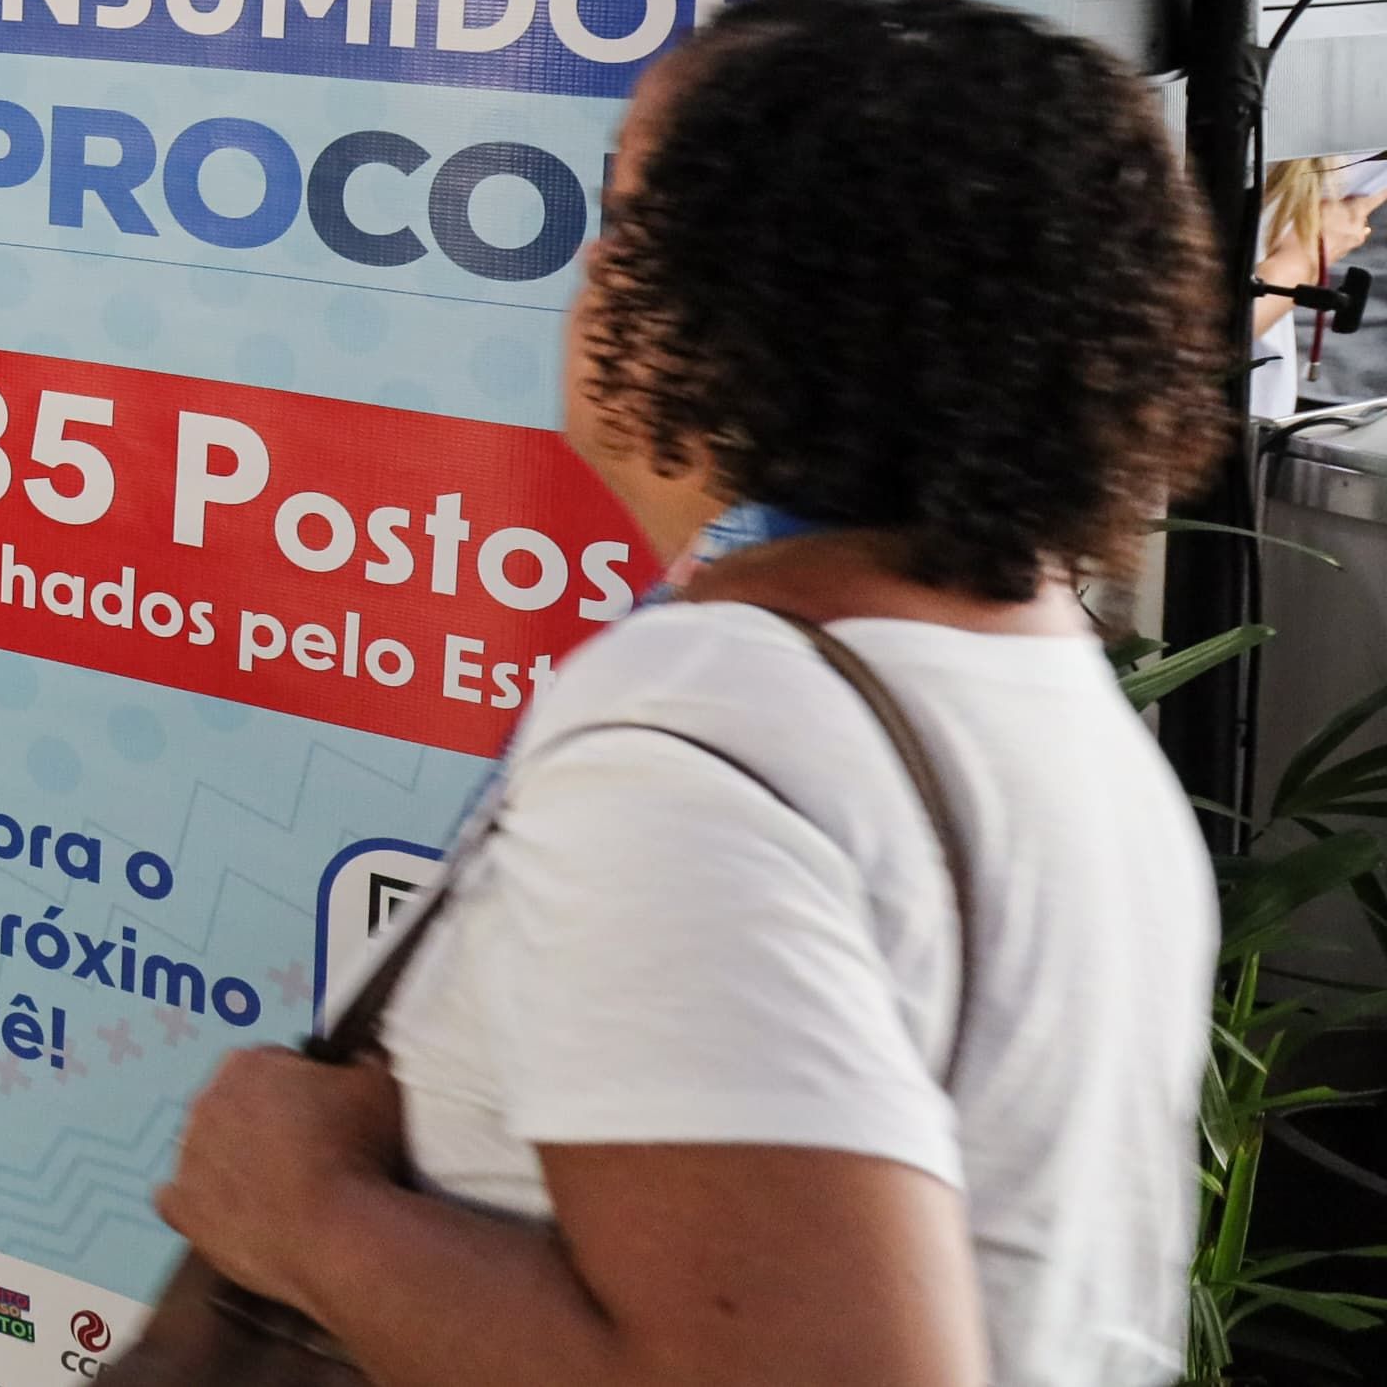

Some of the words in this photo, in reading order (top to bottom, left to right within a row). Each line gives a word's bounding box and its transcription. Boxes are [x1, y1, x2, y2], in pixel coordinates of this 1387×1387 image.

[172, 410, 630, 623] Postos
[238, 607, 416, 689] pelo
[442, 633, 557, 726] Est
[125, 850, 174, 901] o
[61, 1350, 104, 1380] CC
